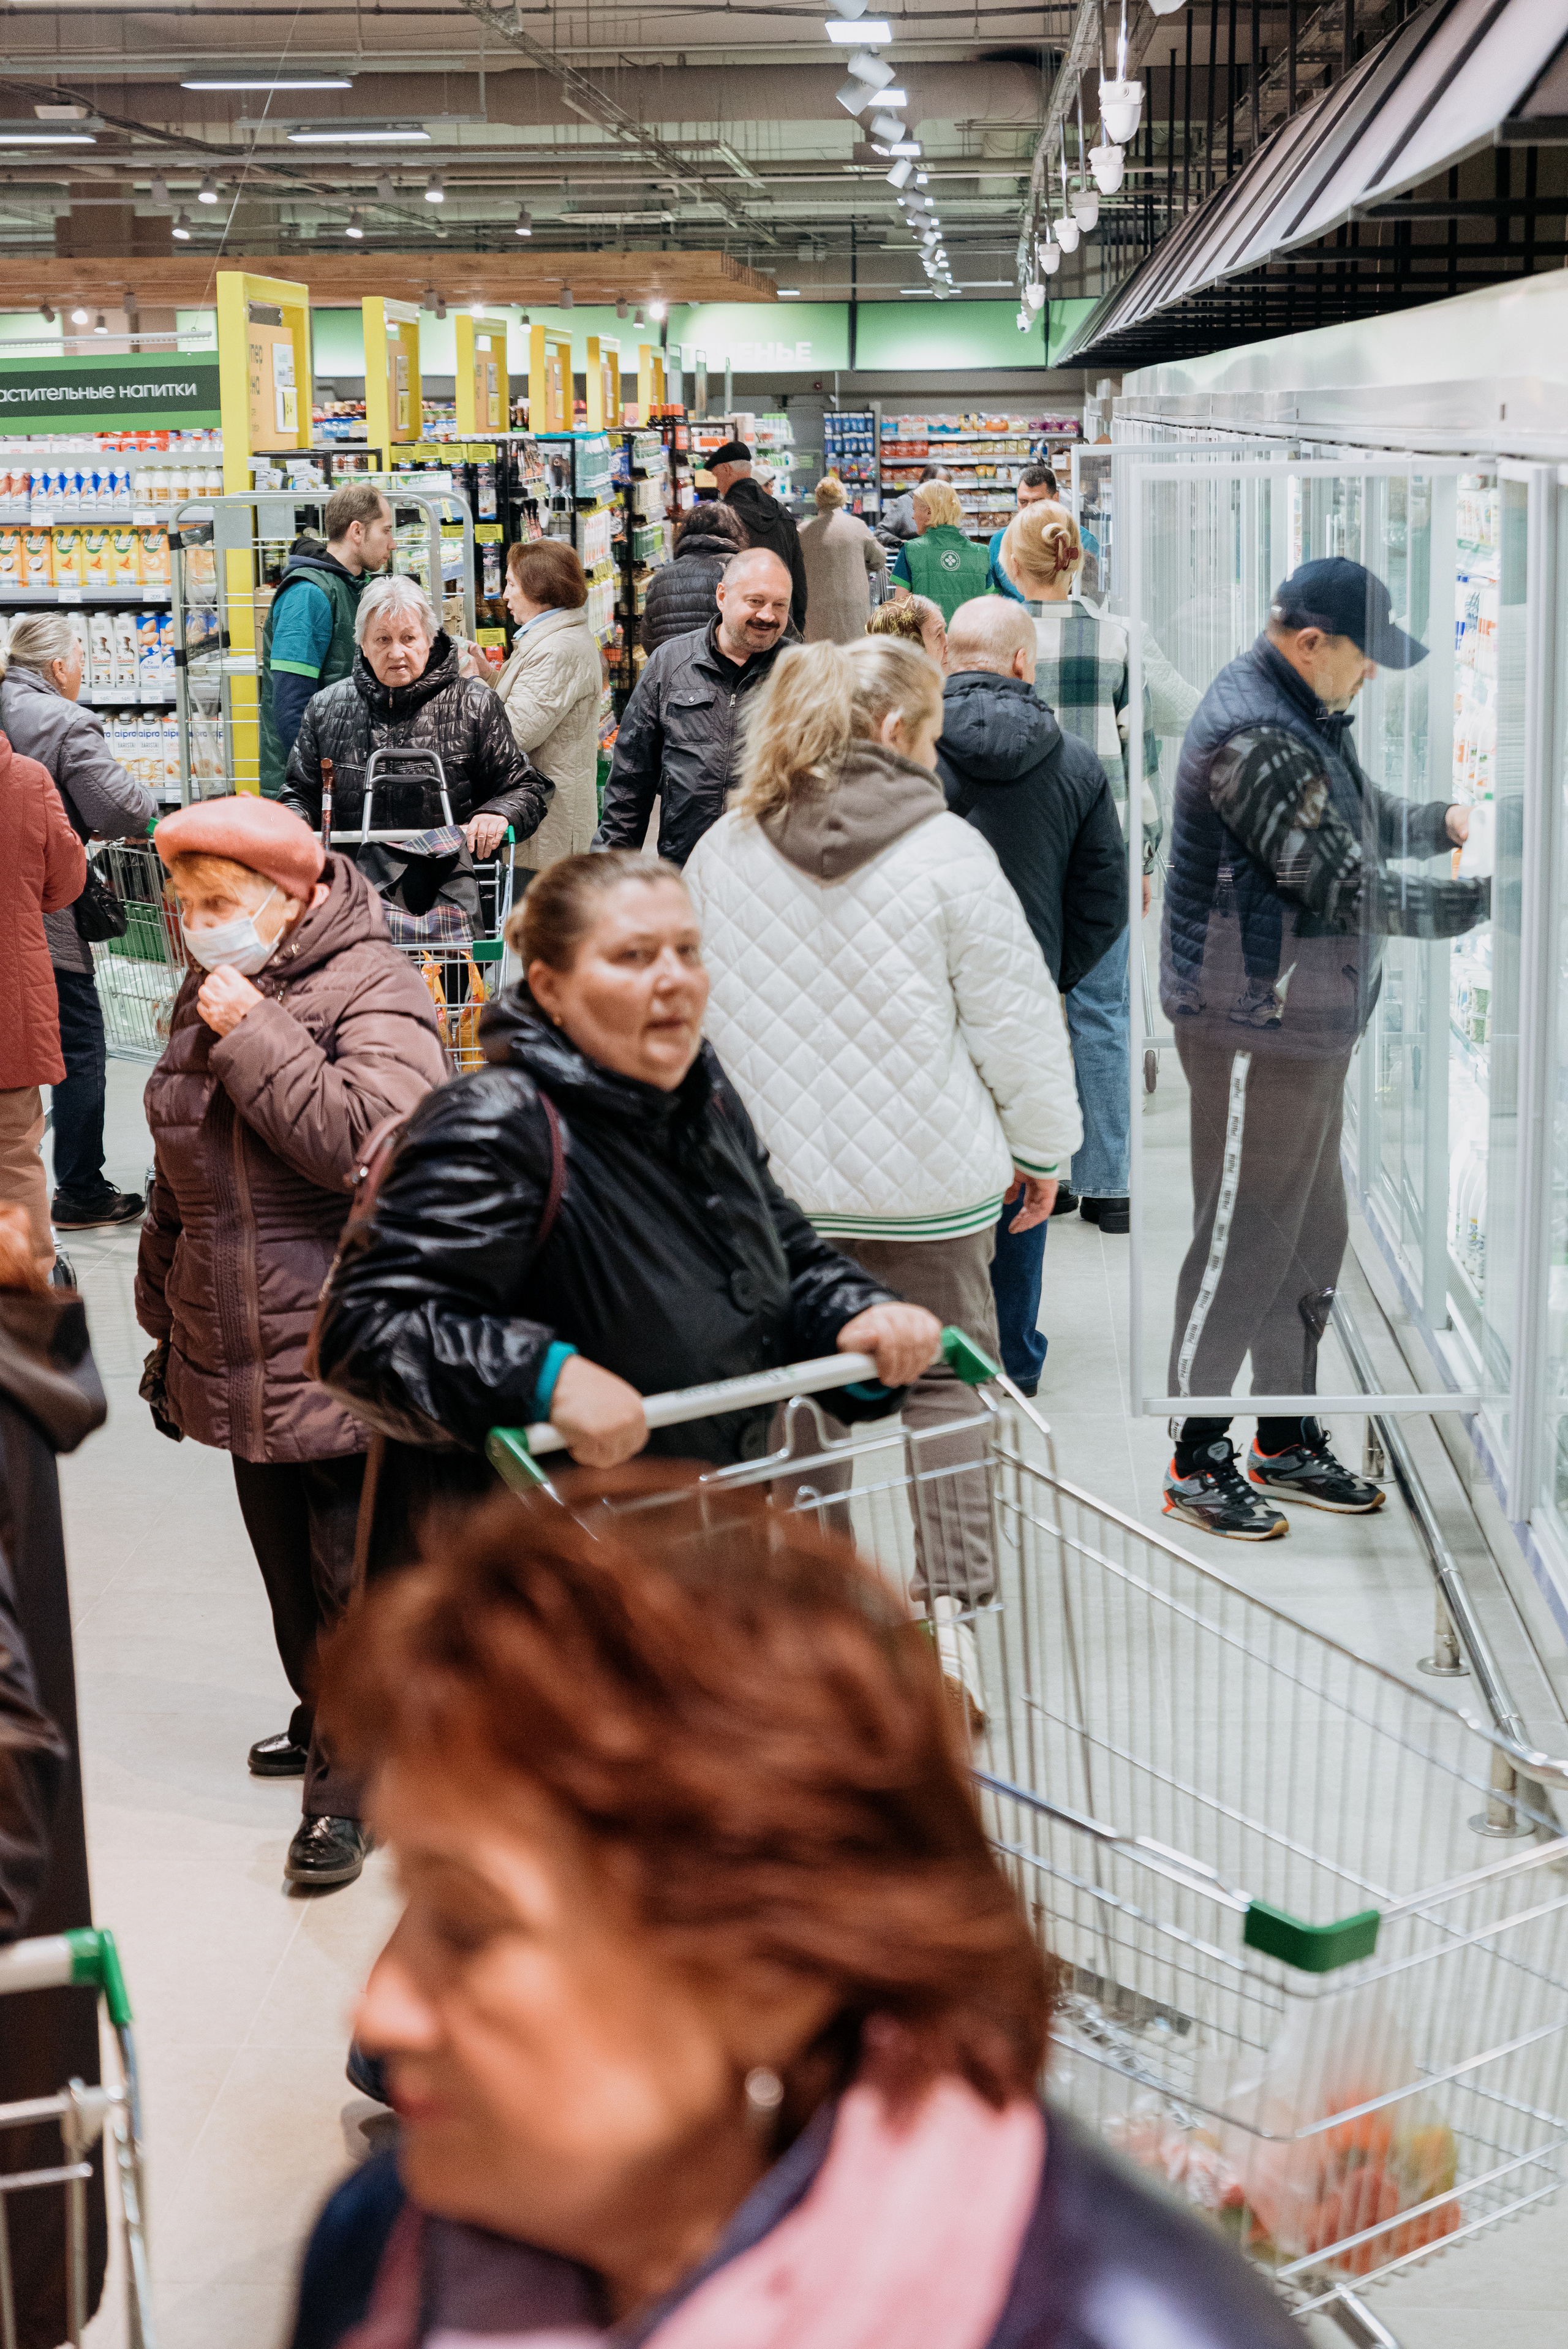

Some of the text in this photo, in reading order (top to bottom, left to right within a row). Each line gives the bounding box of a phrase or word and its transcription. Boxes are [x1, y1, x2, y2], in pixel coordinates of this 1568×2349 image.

[119, 382, 197, 399] напитки
[115, 728, 137, 740] alpro
[138, 728, 160, 740] alpro
[163, 728, 179, 740] alp
